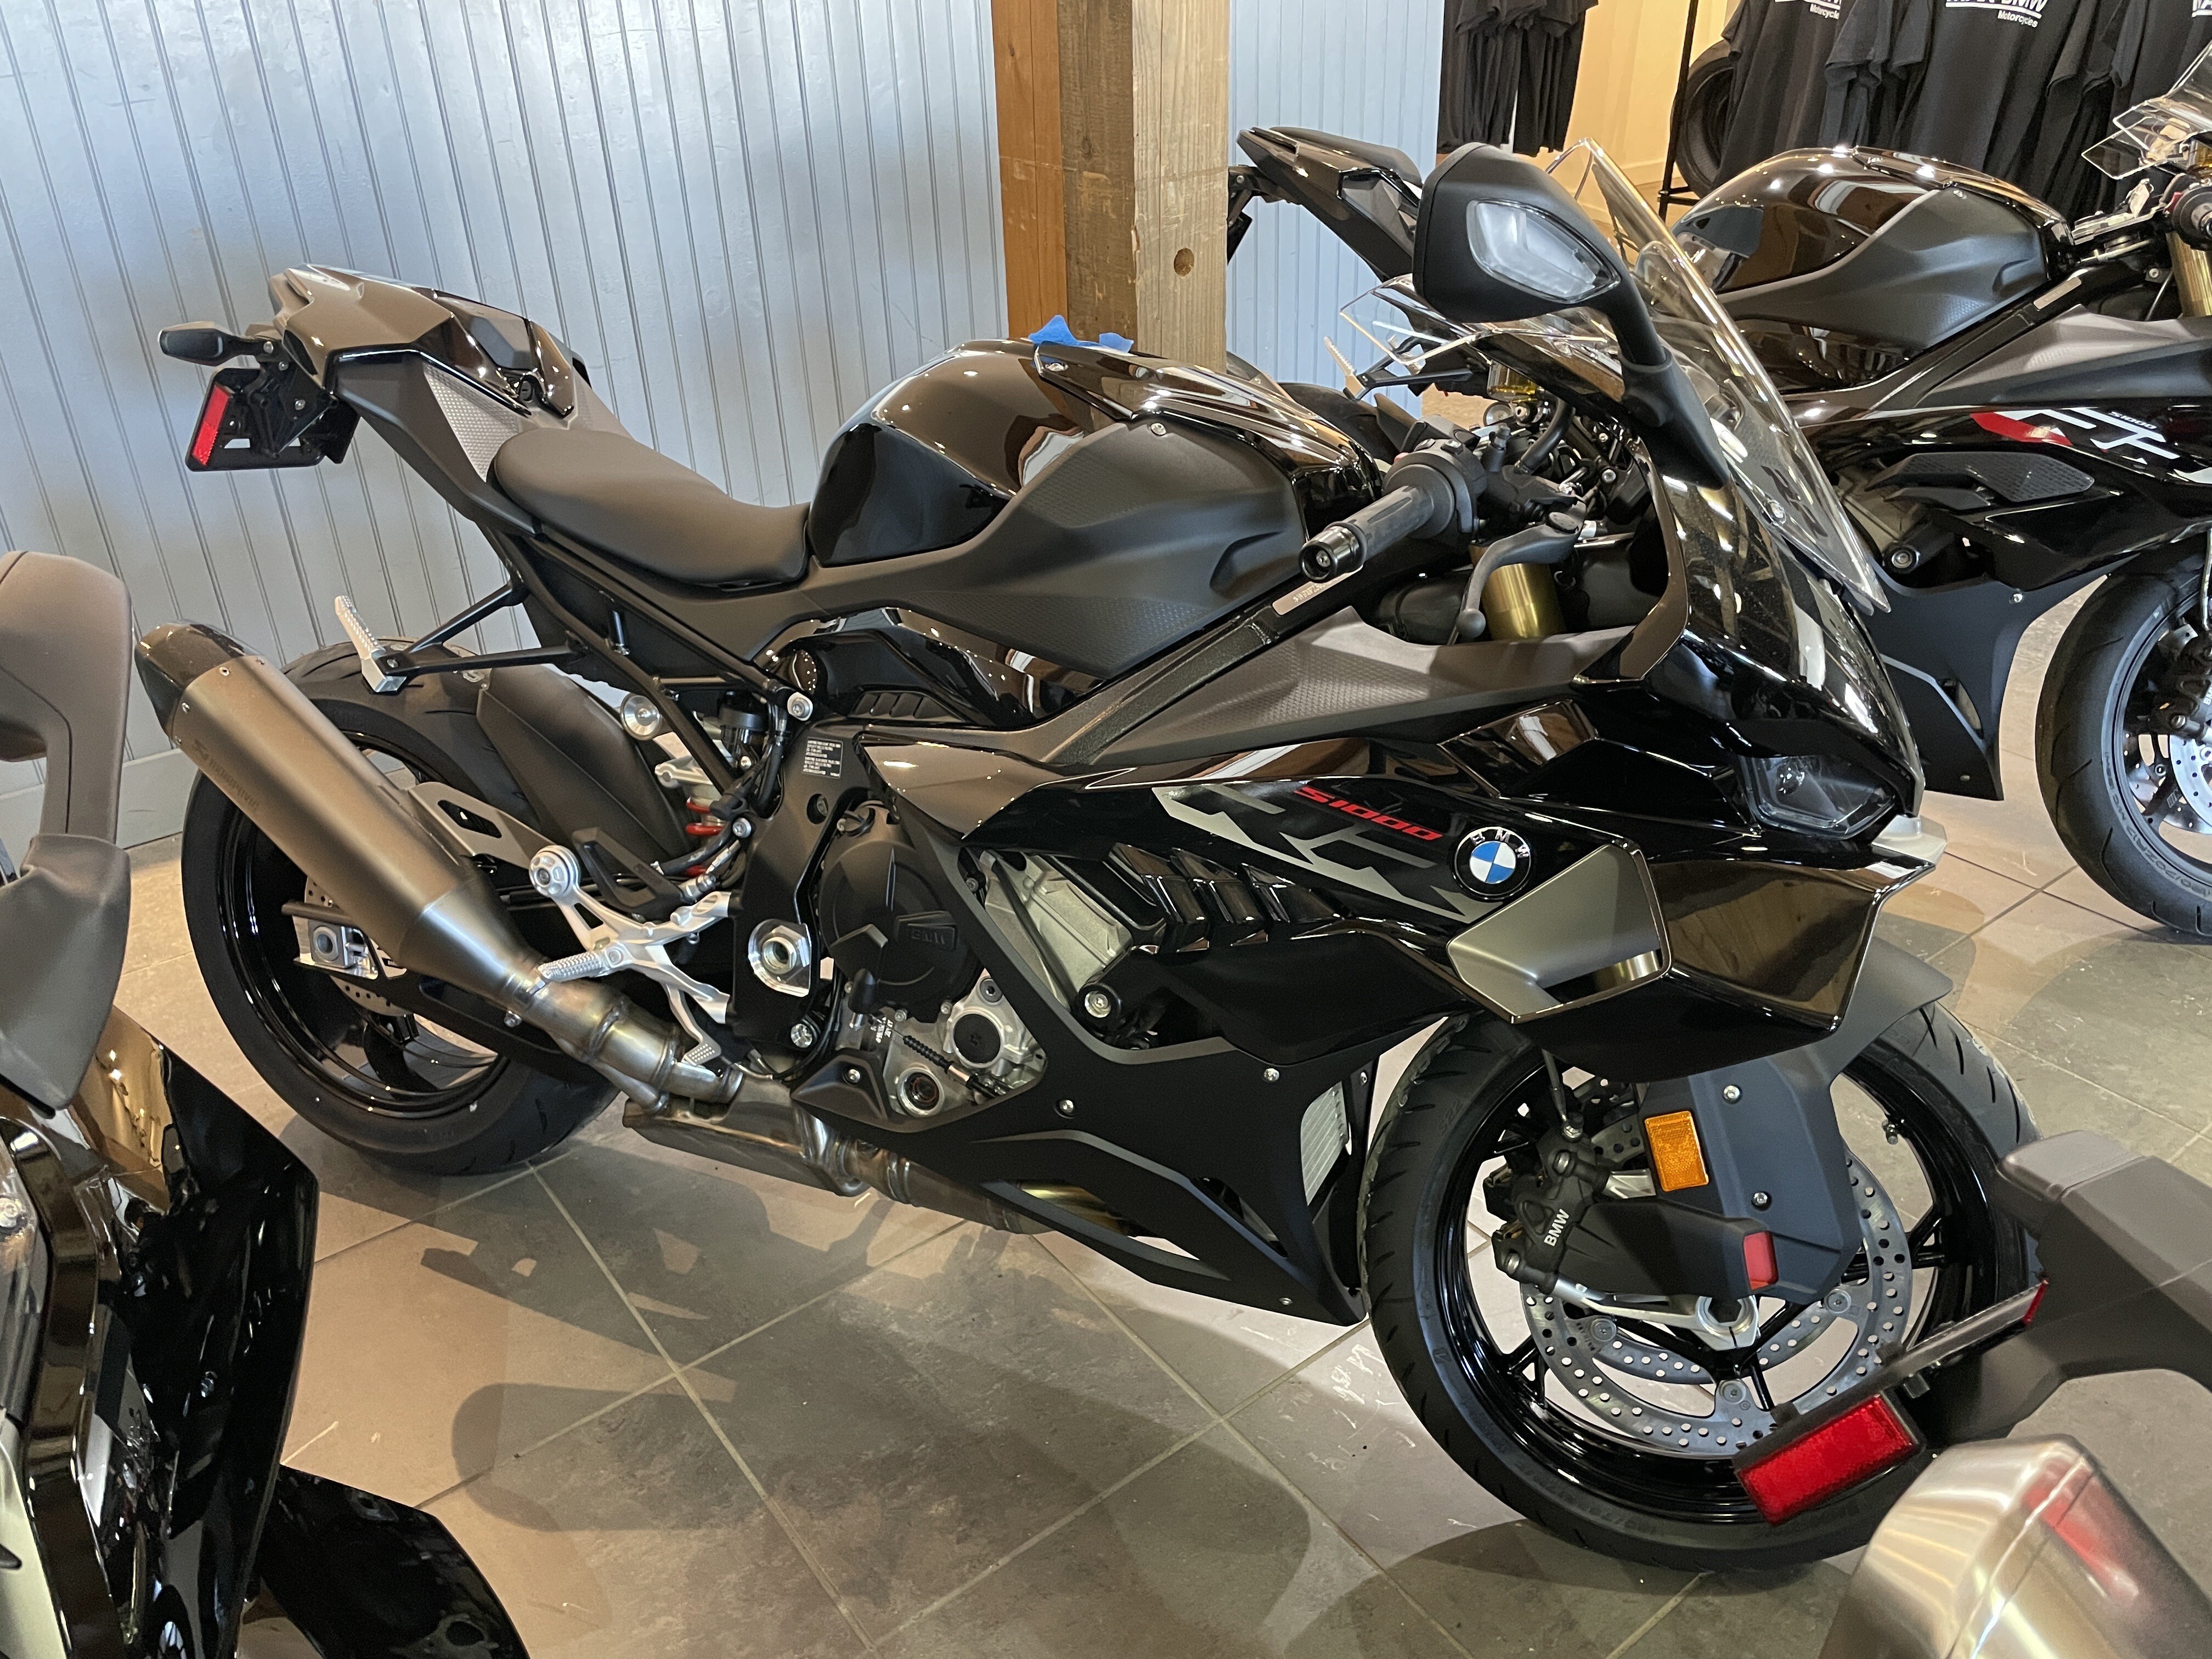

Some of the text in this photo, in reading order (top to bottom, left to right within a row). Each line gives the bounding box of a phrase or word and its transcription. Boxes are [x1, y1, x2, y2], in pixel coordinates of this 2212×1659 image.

[1997, 10, 2039, 28] Motorcycles
[2108, 411, 2157, 430] S1000
[1293, 786, 1443, 840] S1000
[1470, 829, 1530, 859] BMW
[1543, 1209, 1570, 1246] BMW
